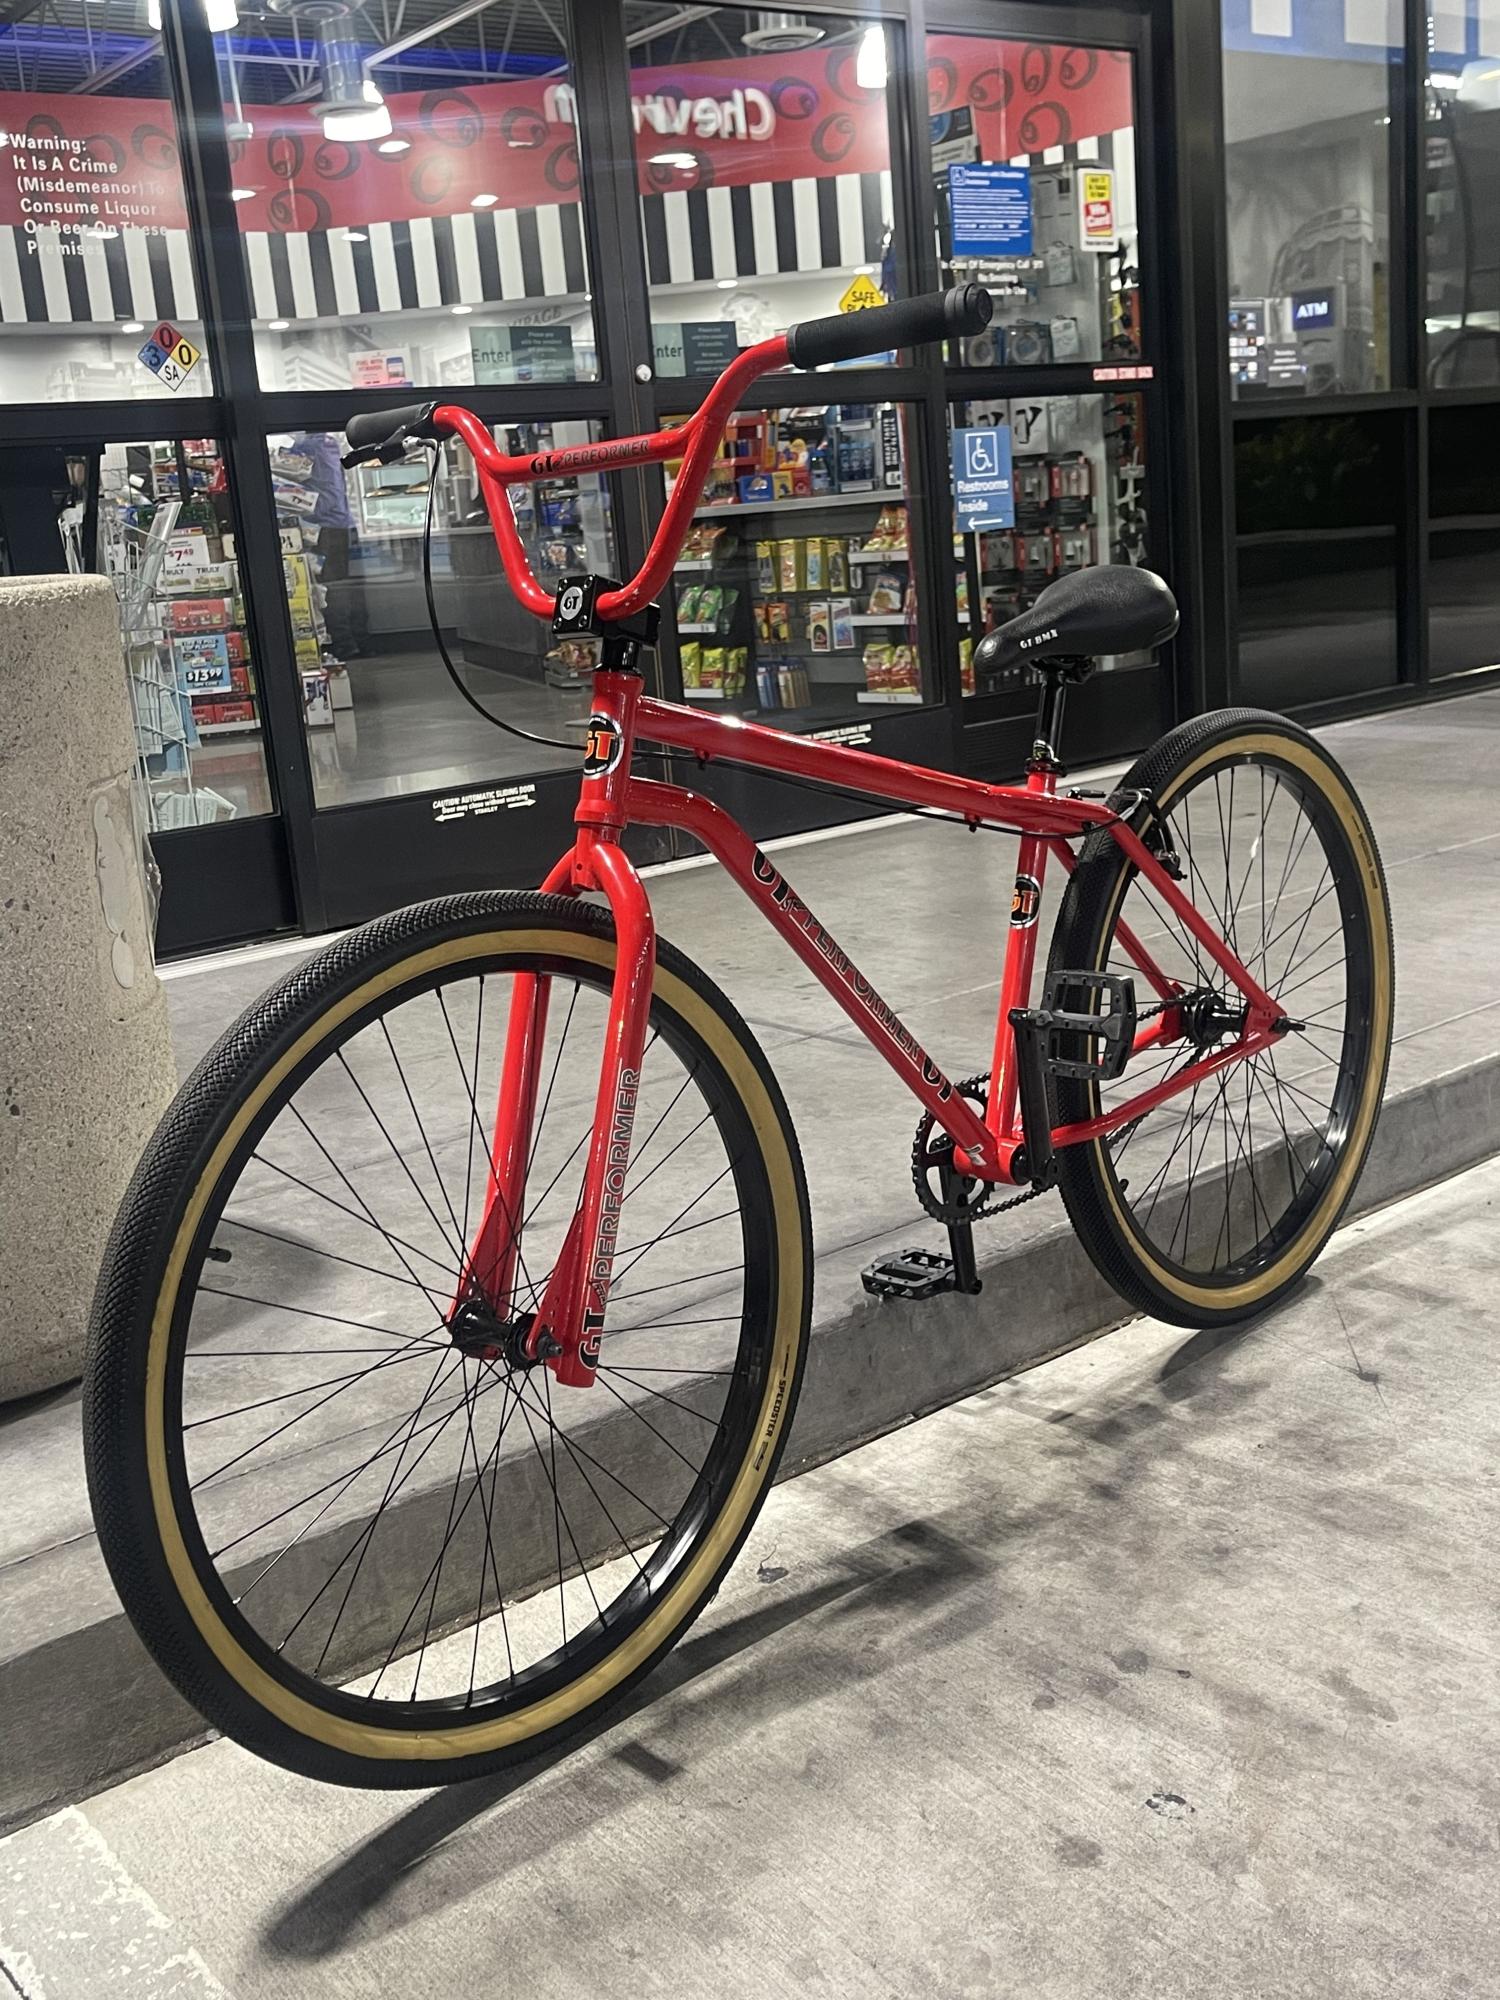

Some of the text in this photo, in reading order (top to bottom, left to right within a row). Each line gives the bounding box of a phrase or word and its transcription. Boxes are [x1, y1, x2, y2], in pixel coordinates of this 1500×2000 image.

[9, 134, 87, 153] Warning:
[12, 155, 118, 173] It Is A Crime
[17, 176, 165, 195] (Misdemeanor) To
[20, 198, 157, 218] Consume Liquor
[24, 219, 168, 236] Or Beer On These
[1296, 301, 1328, 319] ATM
[160, 326, 174, 348] 0
[147, 344, 160, 367] 3
[178, 344, 192, 365] 0
[471, 348, 511, 364] Enter
[656, 344, 683, 358] nter
[164, 364, 180, 381] SA
[562, 439, 650, 467] PERFORMER
[957, 480, 1009, 493] Restrooms
[958, 499, 988, 513] Inside
[564, 595, 580, 610] GT
[1020, 629, 1058, 649] GT BMX
[433, 784, 535, 809] CAUTION AUTOMATIC SLIDING DOOR
[578, 1306, 606, 1371] GT
[593, 1066, 641, 1281] PERFORMER
[765, 1379, 787, 1438] SPEEDSTER
